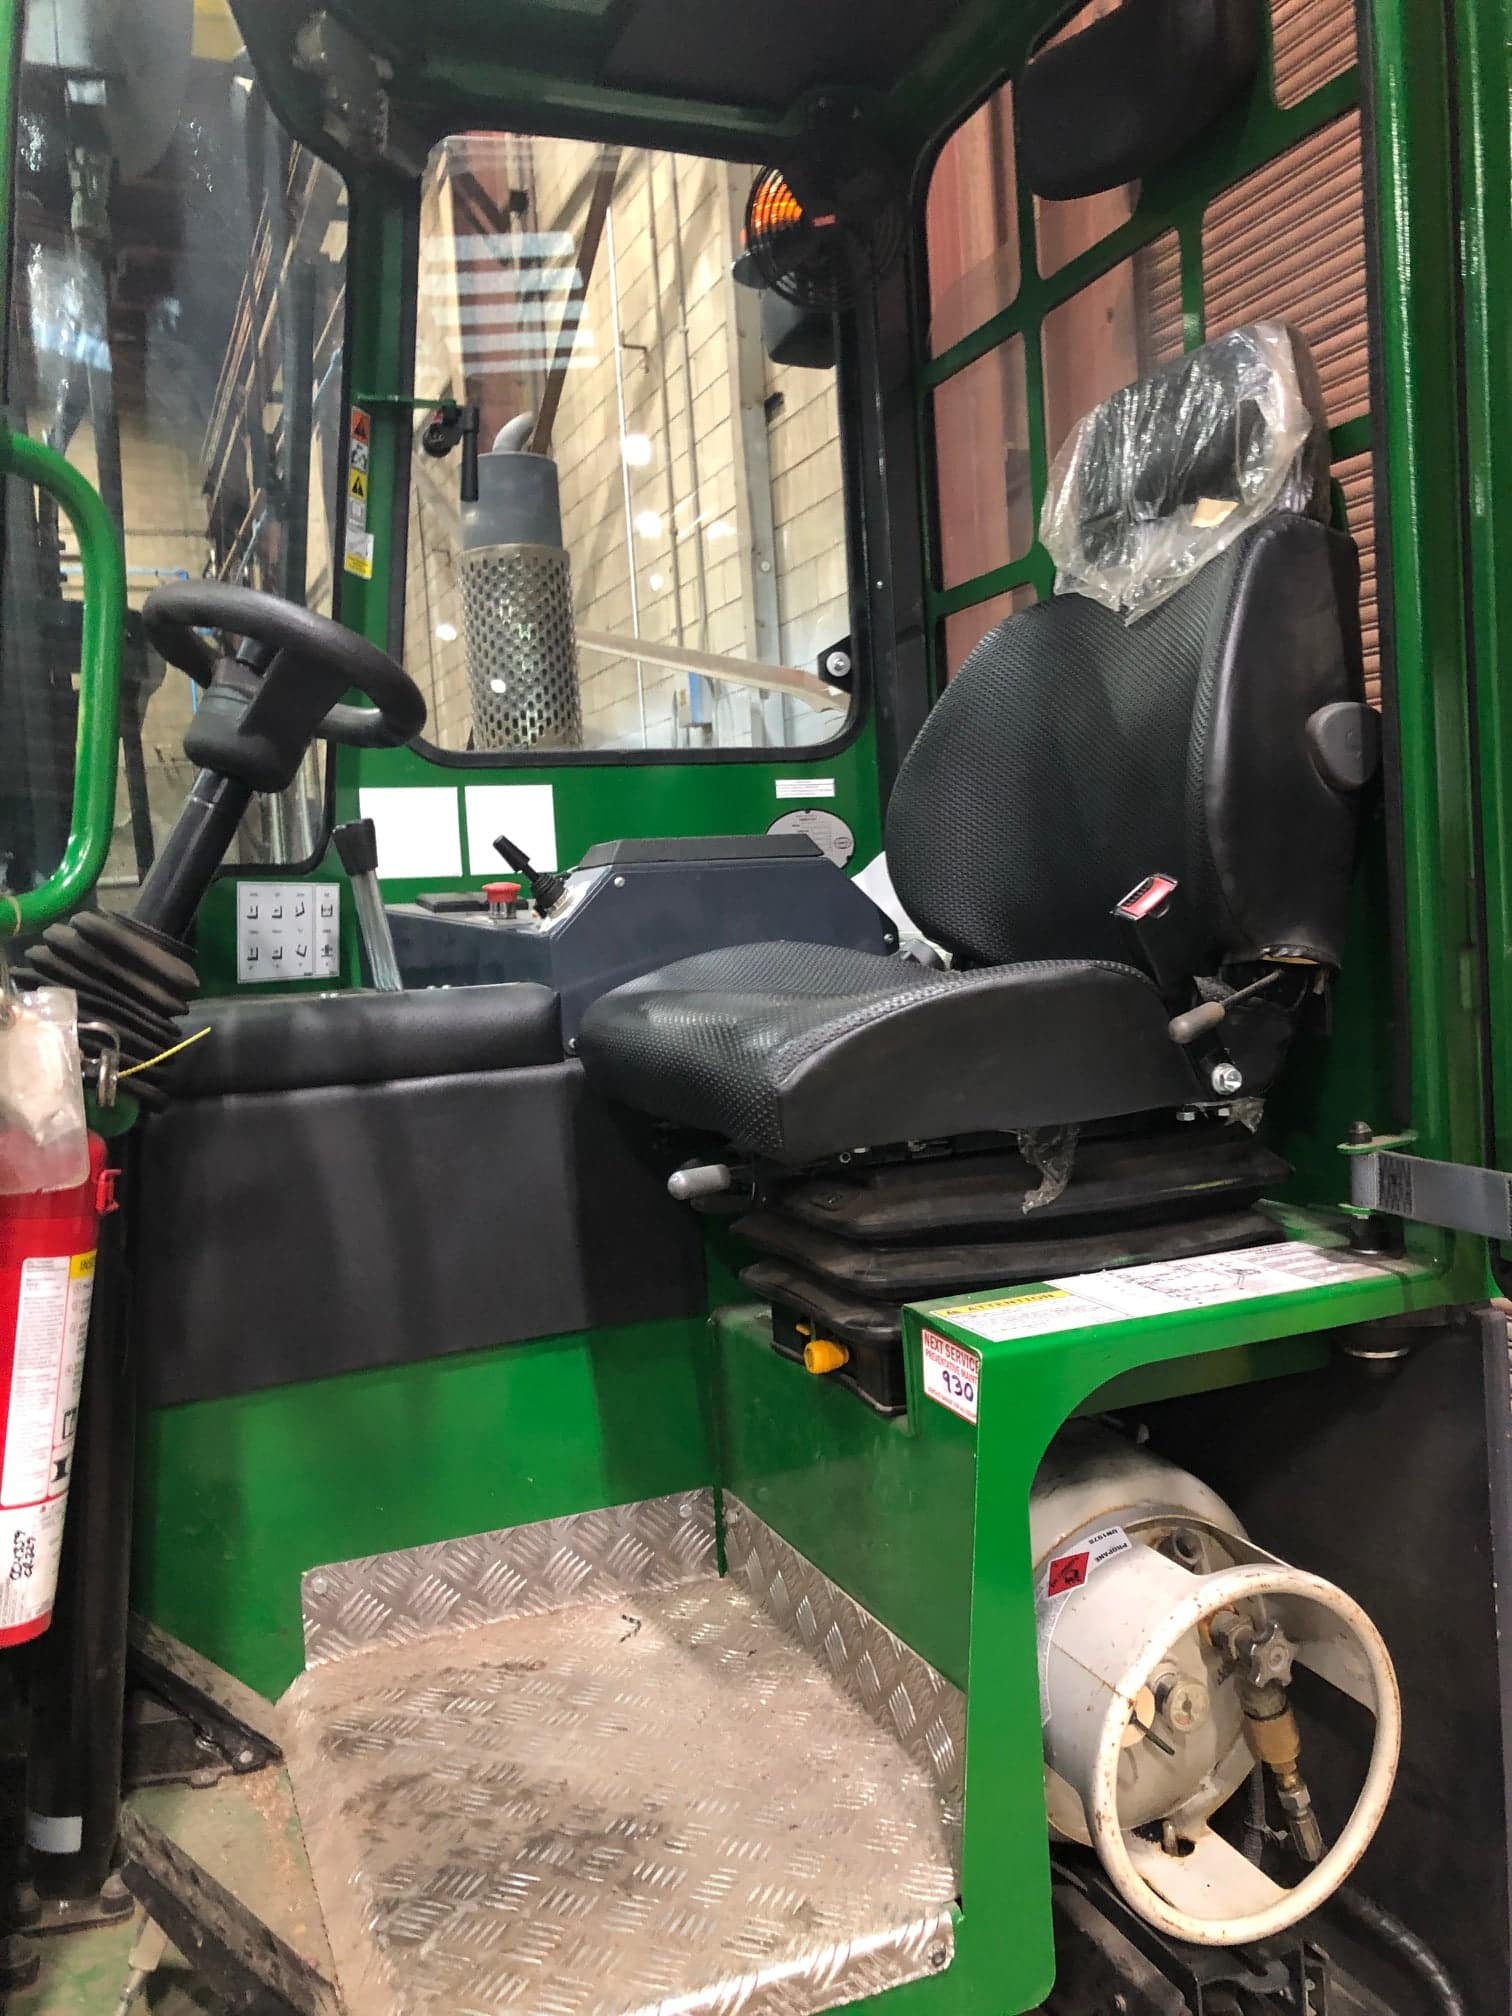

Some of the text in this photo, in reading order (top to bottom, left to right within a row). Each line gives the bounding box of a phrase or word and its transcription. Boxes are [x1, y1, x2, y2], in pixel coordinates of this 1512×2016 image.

[968, 1294, 1055, 1312] ATTENTION
[925, 1333, 979, 1374] NEXT SERVICE
[942, 1370, 974, 1402] 930
[1089, 1529, 1118, 1545] UN1978
[1095, 1543, 1128, 1562] PROPANE
